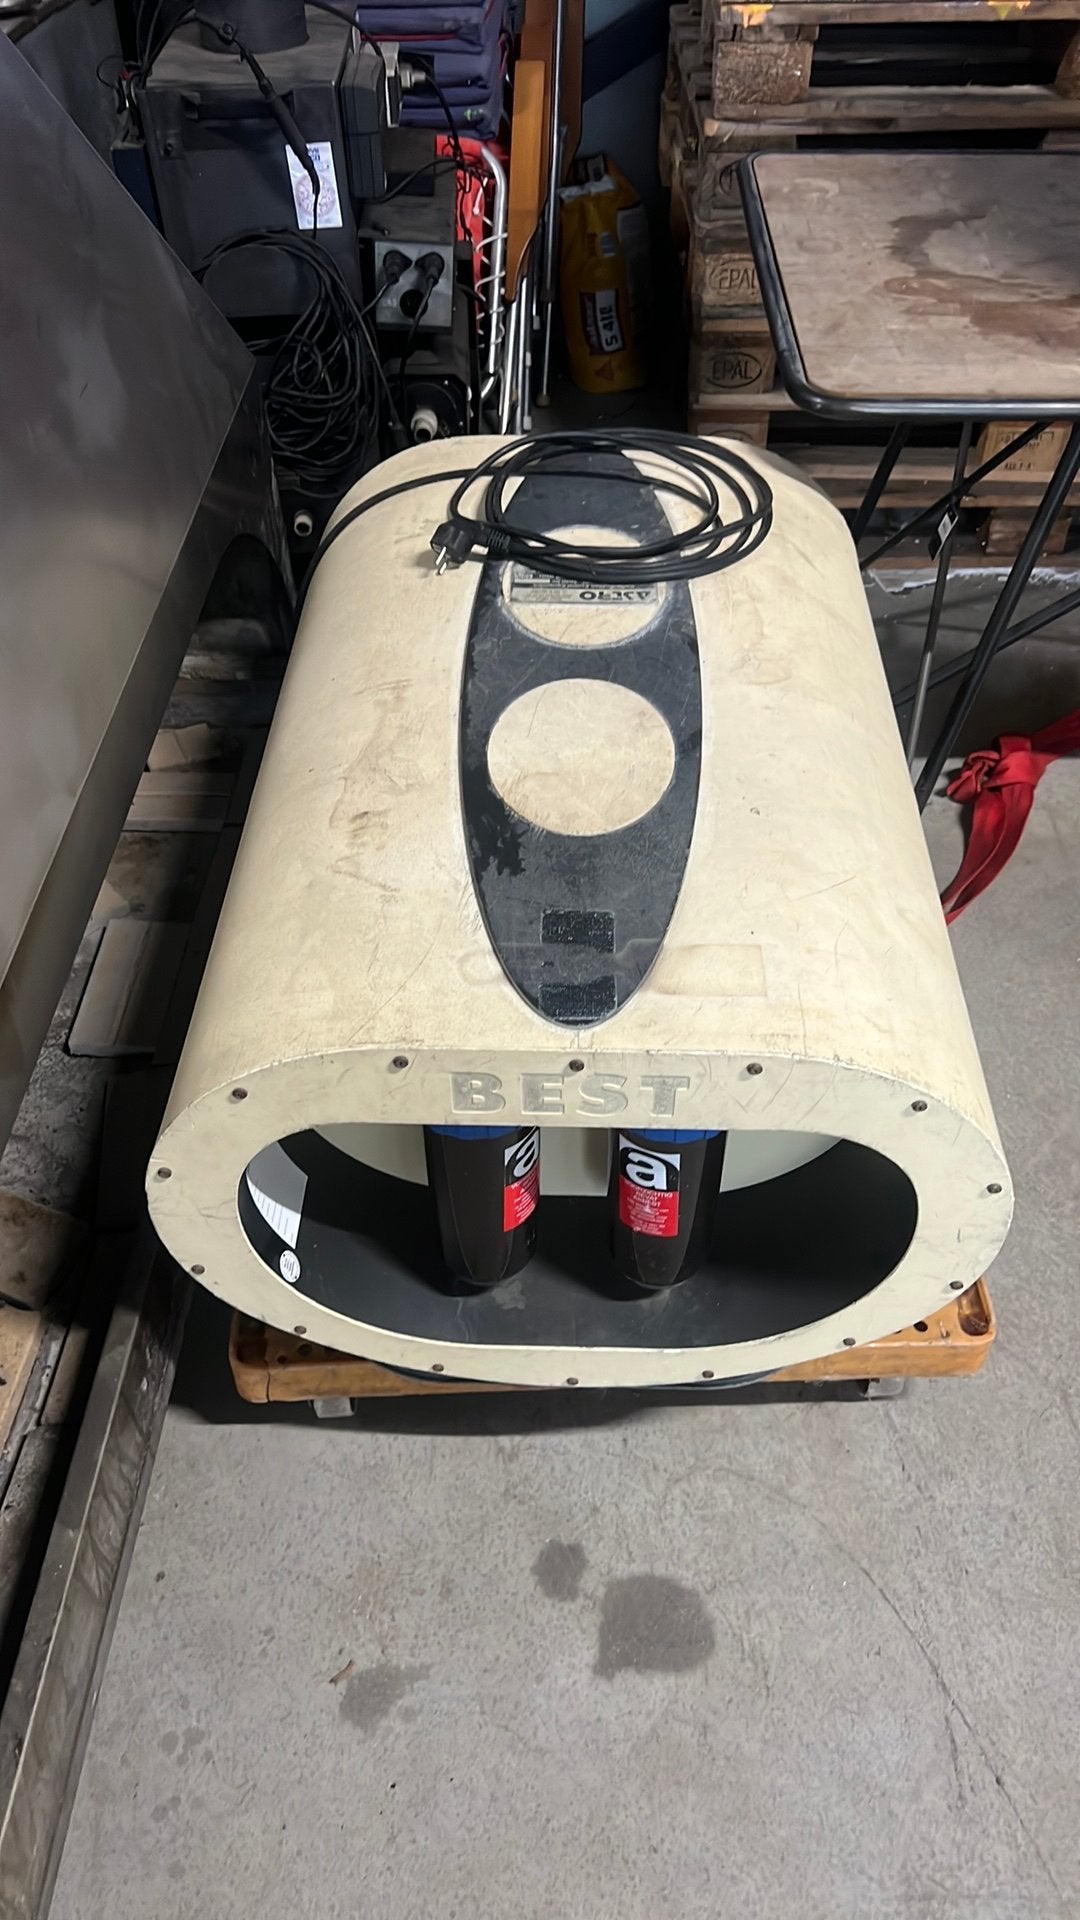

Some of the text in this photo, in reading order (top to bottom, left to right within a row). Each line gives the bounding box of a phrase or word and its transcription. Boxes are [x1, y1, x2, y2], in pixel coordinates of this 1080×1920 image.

[712, 360, 752, 380] EPAL
[450, 1072, 690, 1117] BEST
[626, 1151, 668, 1190] a
